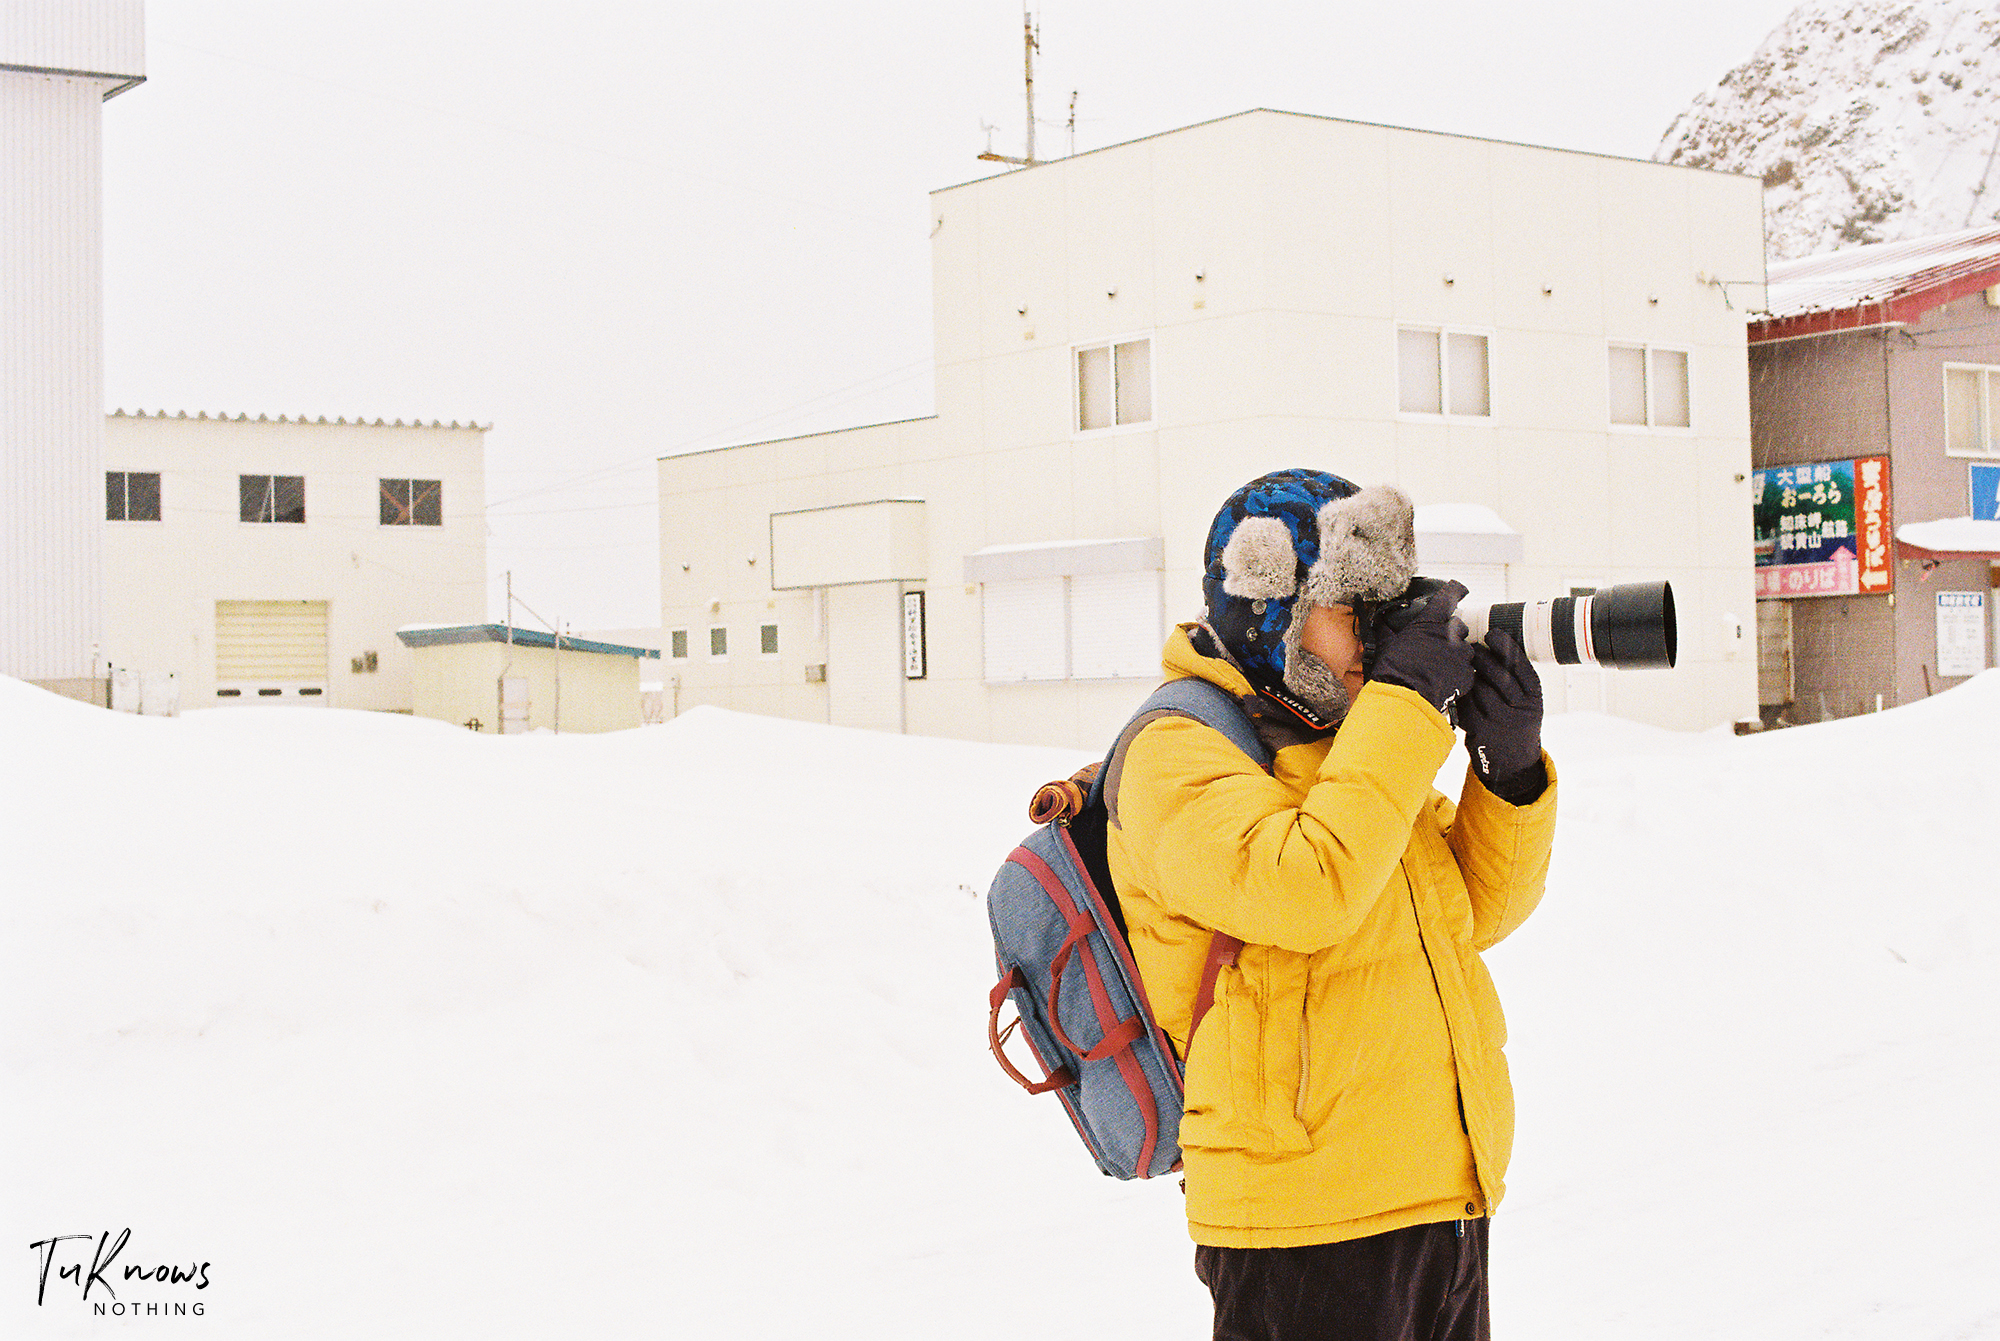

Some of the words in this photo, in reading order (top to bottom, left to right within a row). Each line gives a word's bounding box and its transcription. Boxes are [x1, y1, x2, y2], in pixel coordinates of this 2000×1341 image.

[1777, 464, 1832, 486] 大型船
[1781, 481, 1842, 508] おーろら
